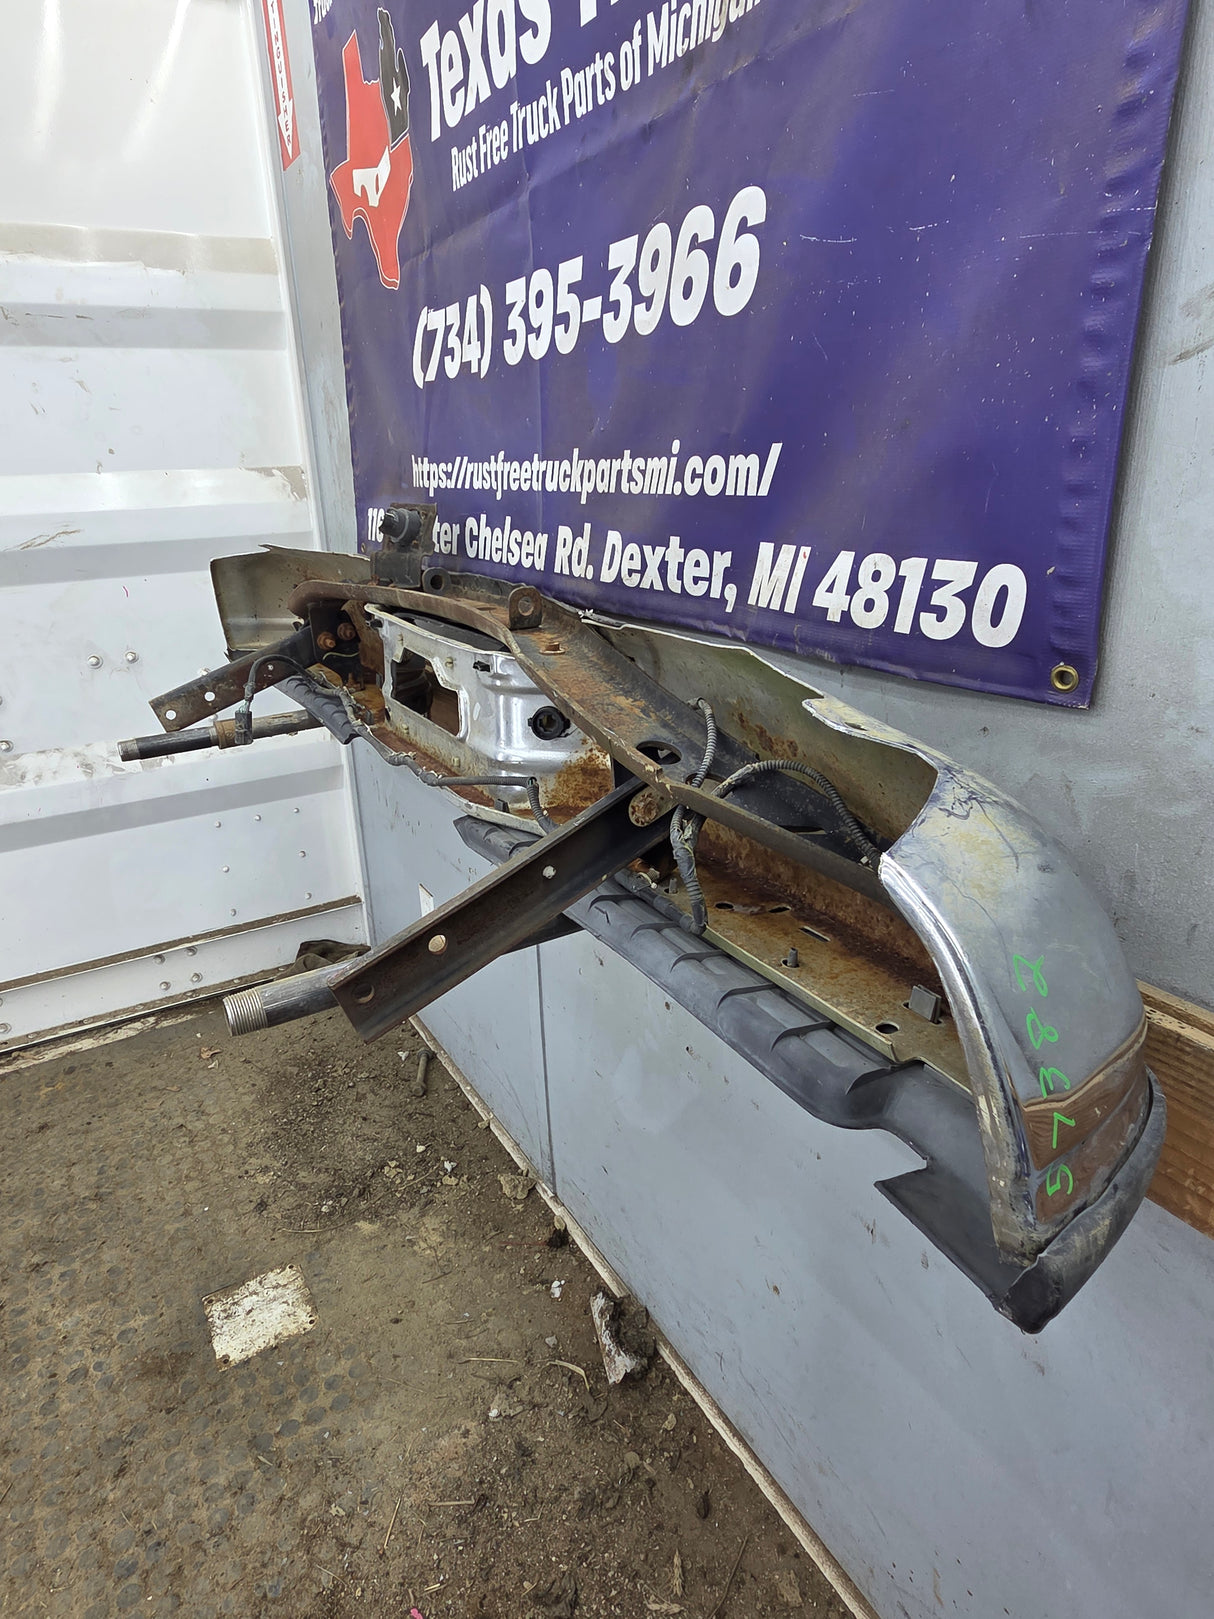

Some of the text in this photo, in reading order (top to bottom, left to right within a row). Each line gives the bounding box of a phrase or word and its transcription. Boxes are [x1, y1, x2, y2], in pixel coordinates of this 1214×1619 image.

[420, 0, 551, 142] Texas
[451, 147, 479, 192] Rust
[478, 119, 509, 175] Free
[510, 80, 561, 153] Truck
[560, 52, 616, 125] Parts
[619, 19, 642, 92] of
[412, 185, 767, 389] (734) 395-3966
[411, 440, 783, 504] https://rustfreetruckpartsmi.com/
[465, 513, 549, 571] Chelsea
[553, 523, 594, 580] Rd.
[600, 530, 738, 613] Dexter,
[747, 542, 812, 614] MI
[812, 550, 1028, 648] 48130
